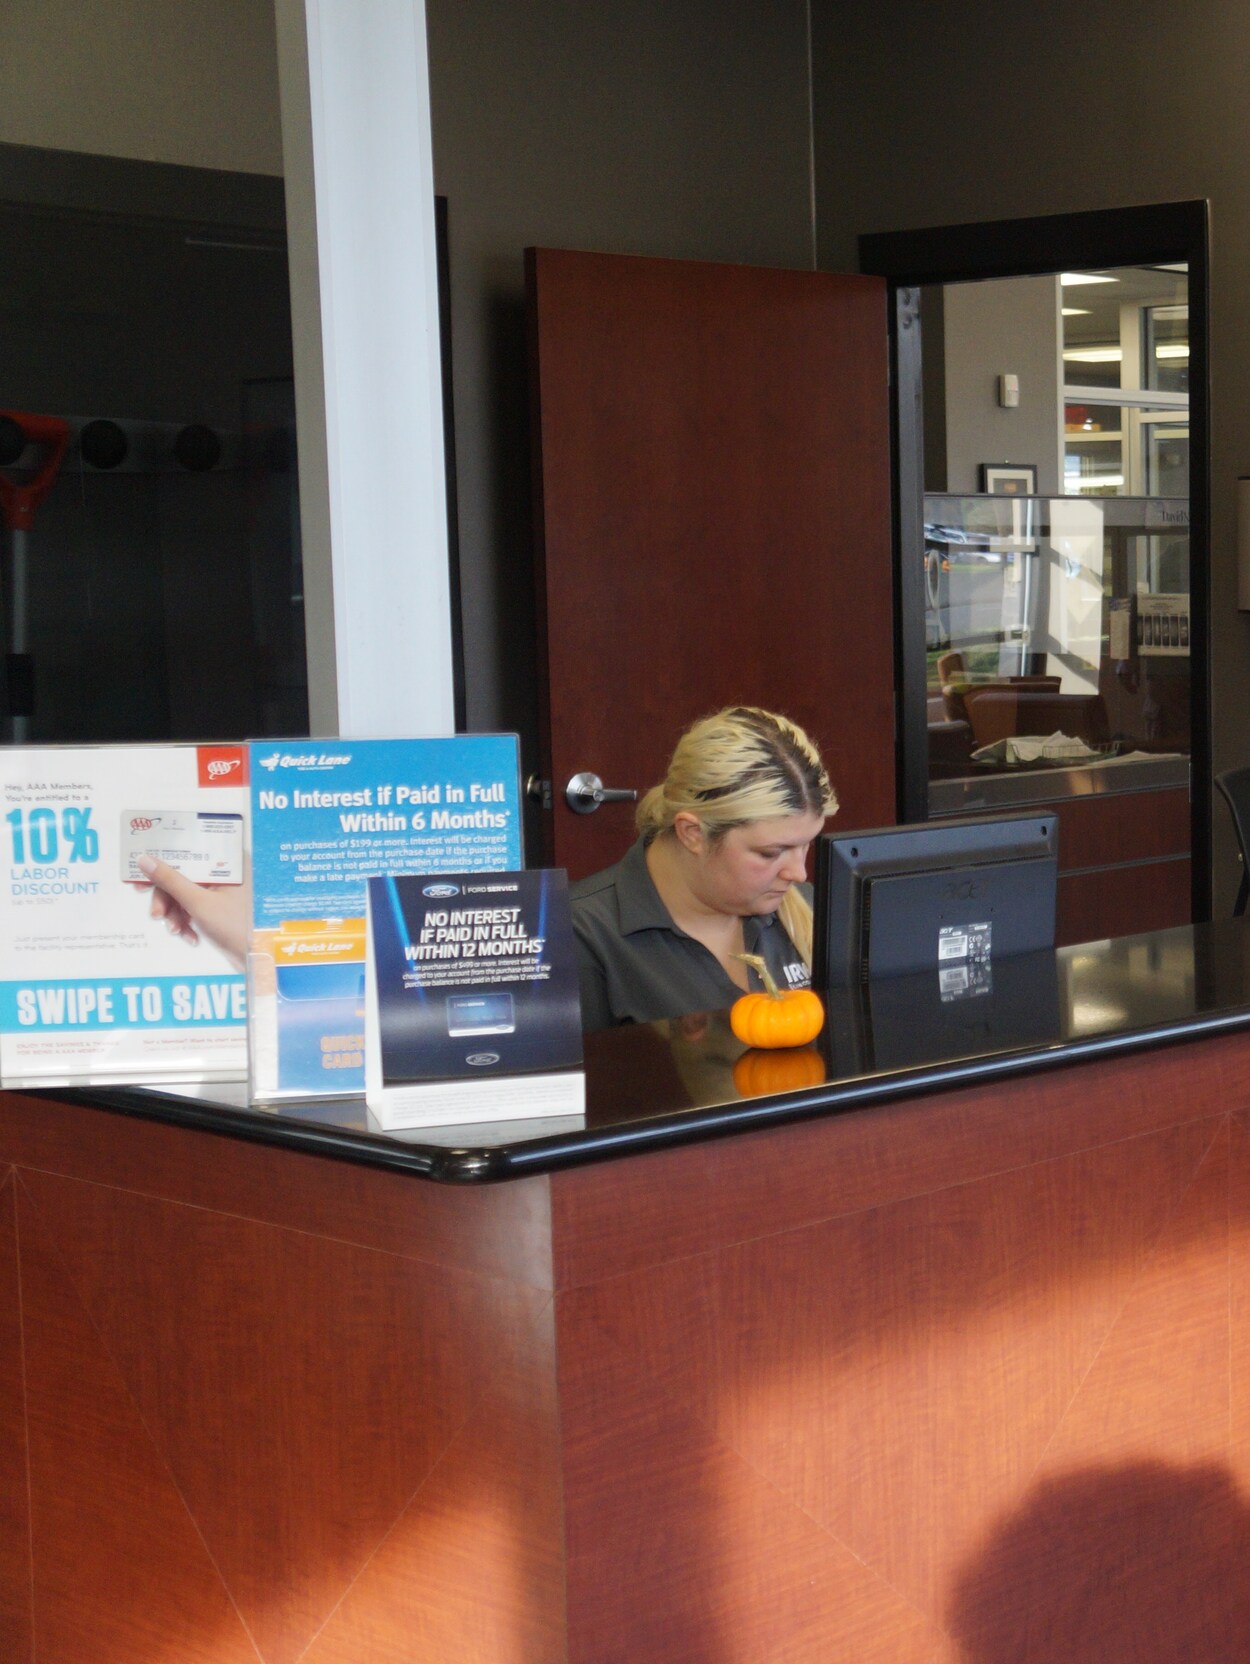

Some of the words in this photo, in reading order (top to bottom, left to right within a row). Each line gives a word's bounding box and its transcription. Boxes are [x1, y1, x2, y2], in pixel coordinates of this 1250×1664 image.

[280, 754, 317, 767] Quick
[318, 754, 352, 766] Lane
[259, 791, 288, 810] No
[293, 788, 373, 808] Interest
[377, 786, 392, 805] if
[396, 784, 440, 804] Paid
[445, 784, 464, 803] in
[470, 783, 505, 803] Full
[340, 812, 407, 833] Within
[411, 812, 425, 830] 6
[6, 806, 99, 864] 10%
[294, 842, 337, 851] purchases
[339, 840, 349, 848] of
[350, 839, 371, 848] $199
[410, 837, 442, 845] Interest
[461, 835, 472, 843] be
[473, 835, 507, 844] charged
[280, 853, 289, 861] to
[291, 854, 309, 863] your
[312, 851, 346, 860] account
[347, 850, 366, 858] from
[369, 849, 383, 858] the
[385, 848, 424, 858] purchase
[425, 847, 444, 856] date
[446, 846, 453, 855] if
[454, 846, 467, 854] the
[469, 845, 507, 855] purchase
[298, 863, 332, 871] balance
[334, 862, 341, 870] is
[343, 861, 357, 869] not
[359, 860, 378, 870] paid
[380, 860, 388, 868] in
[389, 859, 404, 867] full
[406, 858, 431, 867] within
[433, 858, 439, 866] 6
[440, 857, 472, 866] months
[485, 856, 492, 864] if
[492, 857, 507, 865] you
[10, 867, 70, 880] LABOR
[294, 874, 318, 882] make
[327, 873, 343, 881] late
[11, 882, 99, 896] DISCOUNT
[425, 912, 448, 927] NO
[450, 908, 521, 926] INTEREST
[420, 929, 434, 943] IF
[436, 927, 471, 942] PAID
[474, 926, 489, 940] IN
[492, 923, 527, 939] FULL
[297, 943, 326, 953] Quick
[327, 942, 354, 951] Lane
[404, 944, 460, 960] WITHIN
[462, 943, 476, 957] 12
[402, 972, 426, 980] charged
[496, 967, 521, 975] purchase
[405, 981, 431, 989] purchase
[471, 977, 484, 985] paid
[16, 987, 115, 1026] SWIPE
[122, 985, 162, 1022] TO
[172, 984, 246, 1020] SAVE
